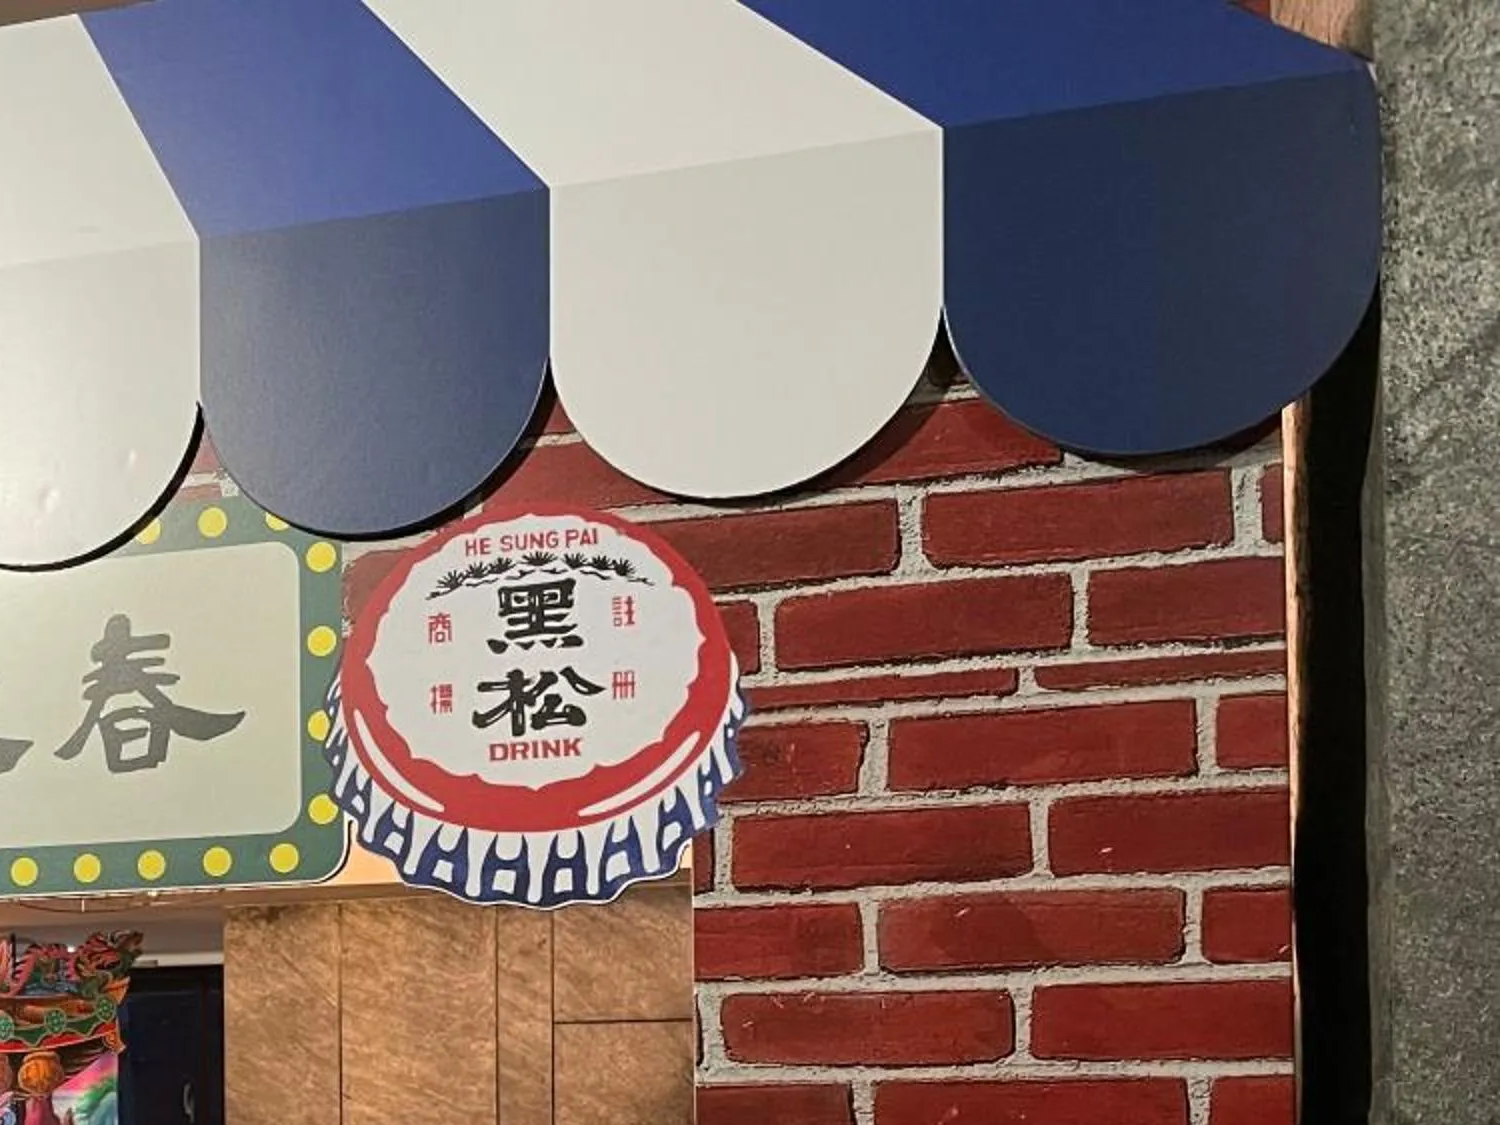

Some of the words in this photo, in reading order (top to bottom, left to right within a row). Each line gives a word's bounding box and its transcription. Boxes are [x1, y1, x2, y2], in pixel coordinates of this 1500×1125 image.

[465, 535, 491, 556] HE
[500, 531, 560, 553] SUNG
[565, 527, 599, 547] PAI
[427, 612, 454, 715] 商標
[472, 577, 607, 738] 黑松
[488, 737, 582, 762] DRINK
